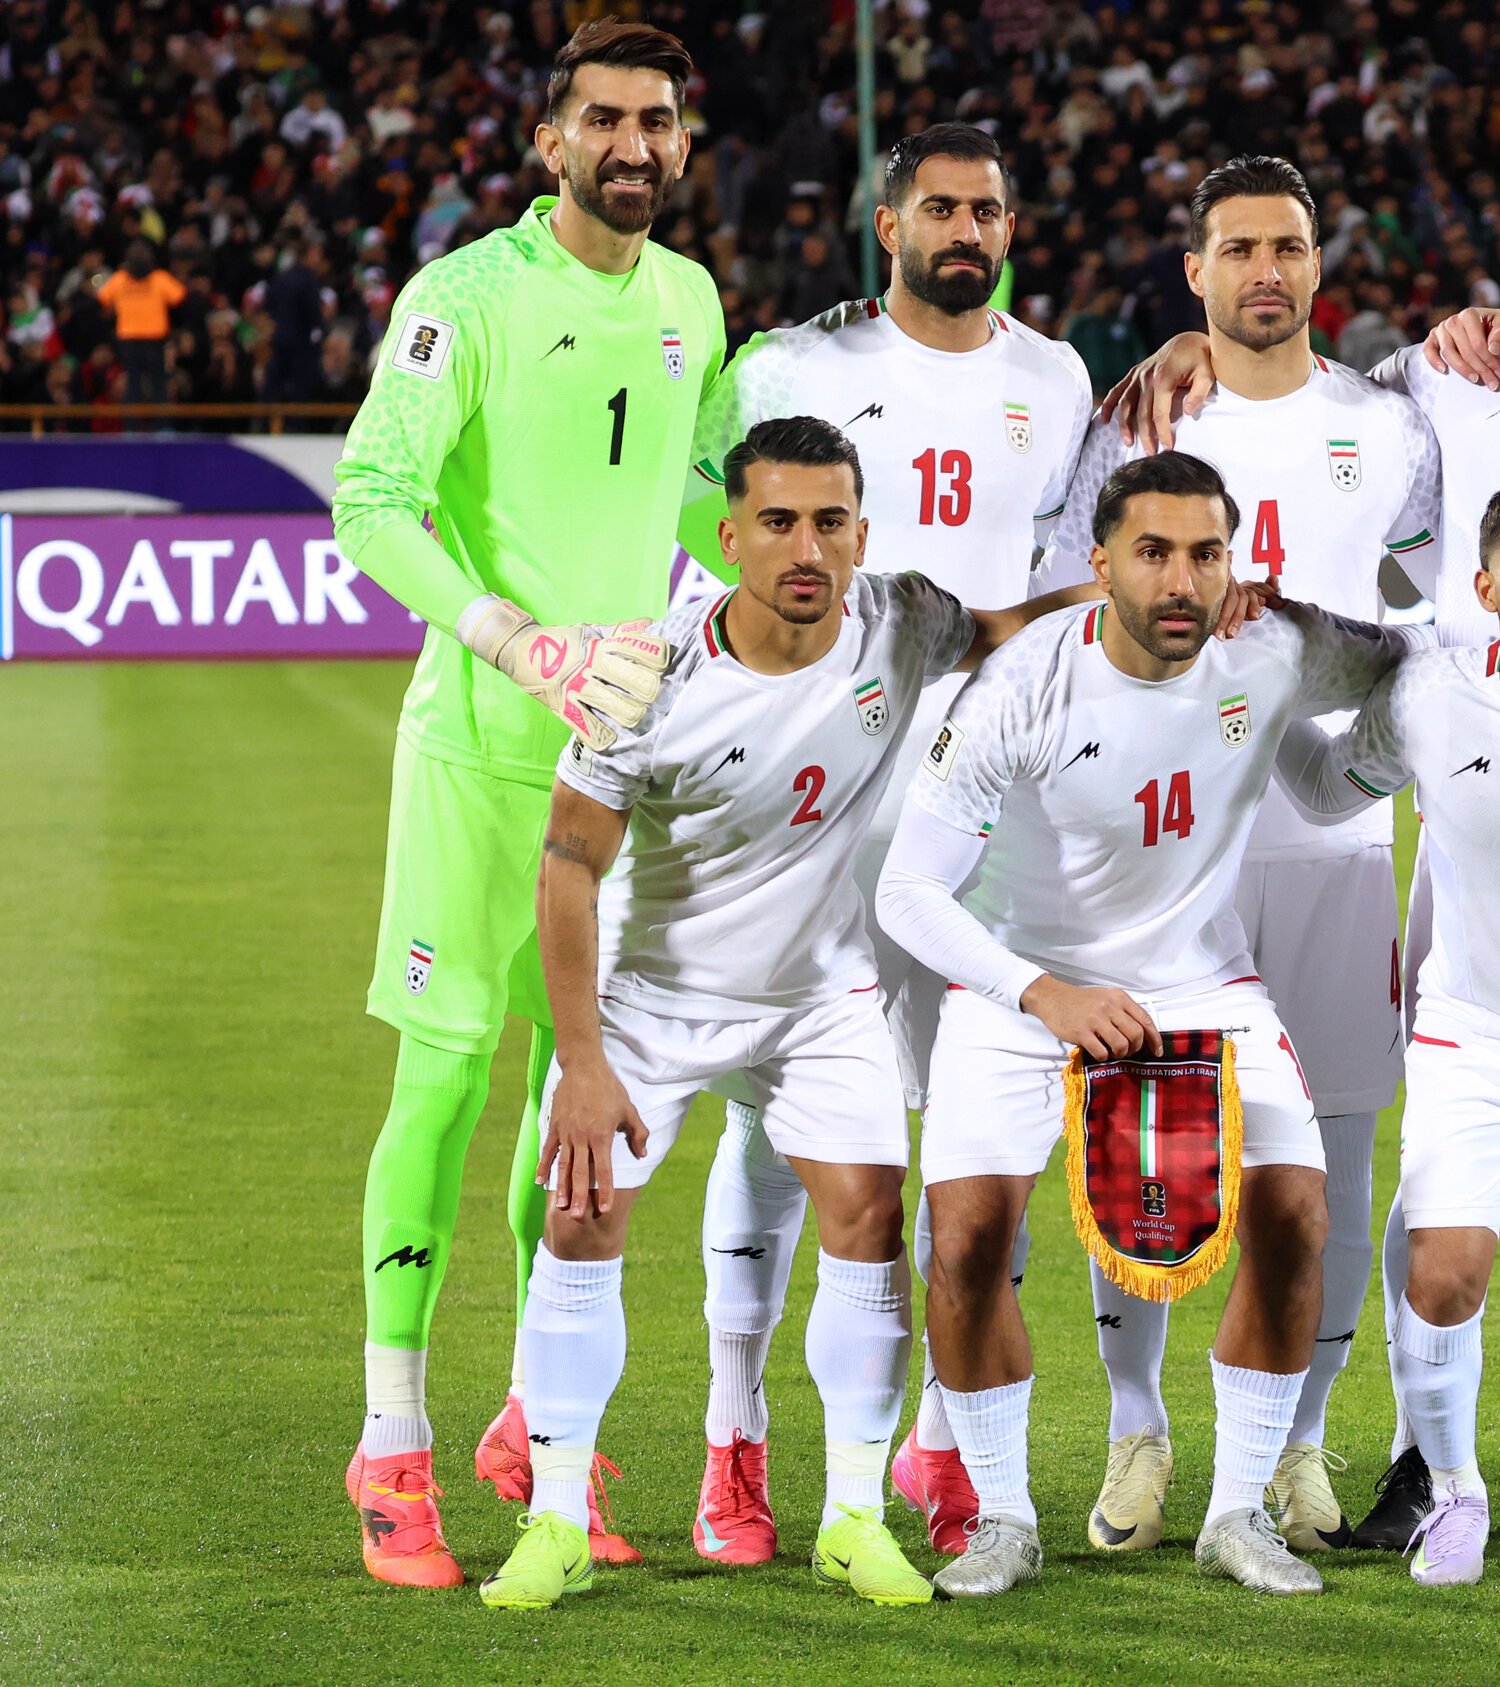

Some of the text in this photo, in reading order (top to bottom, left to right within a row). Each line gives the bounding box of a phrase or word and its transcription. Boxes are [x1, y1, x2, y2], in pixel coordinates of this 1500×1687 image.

[608, 388, 628, 466] 1
[913, 448, 973, 526] 13
[1252, 500, 1286, 575] 4
[17, 539, 369, 647] QATAR
[606, 636, 661, 656] RAPTOR
[790, 765, 826, 826] 2
[1134, 770, 1195, 847] 14
[1089, 1066, 1129, 1079] FOOTBALL
[1131, 1067, 1184, 1077] FEDERATION
[1196, 1067, 1217, 1078] IRAN
[1132, 1219, 1175, 1232] World Cup
[1135, 1230, 1174, 1242] Qualifires
